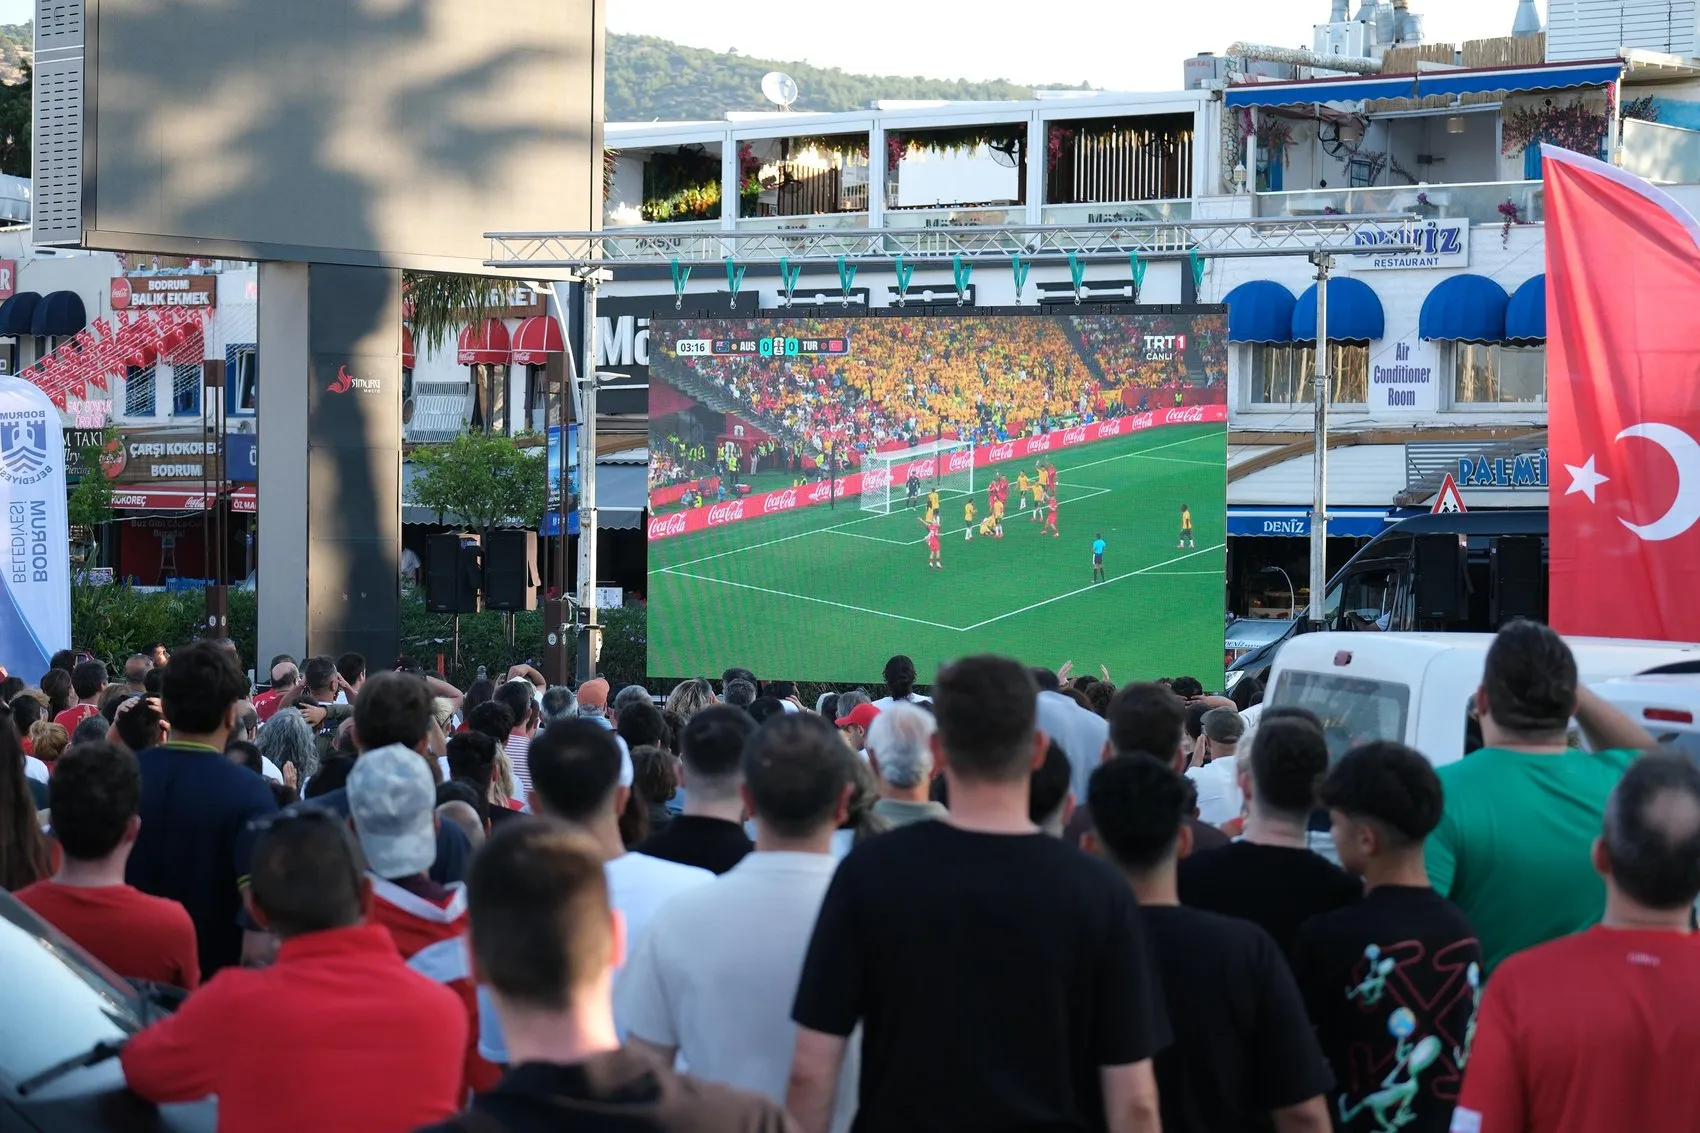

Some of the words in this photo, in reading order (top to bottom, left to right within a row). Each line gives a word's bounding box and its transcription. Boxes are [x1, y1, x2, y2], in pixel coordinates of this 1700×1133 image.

[1374, 257, 1440, 268] RESTAURANT
[148, 279, 190, 291] BODRUM
[131, 293, 167, 306] BALIK
[167, 292, 210, 305] EKMEK
[680, 342, 706, 352] 03:16
[739, 341, 756, 351] AUS
[763, 341, 769, 352] 0
[788, 341, 795, 352] 0
[802, 340, 818, 351] TUR
[1395, 342, 1410, 361] Air
[1146, 352, 1173, 361] CANLI
[1373, 365, 1432, 384] Conditioner
[1387, 387, 1416, 406] Room
[1165, 405, 1204, 423] Coca-Cola
[129, 442, 167, 458] ÇARŞI
[151, 464, 203, 477] BODRUM
[764, 489, 797, 513] Coca-Cola
[708, 499, 744, 525] Coca-Cola
[648, 513, 687, 538] Coca-Cola
[1263, 518, 1305, 534] DENİZ
